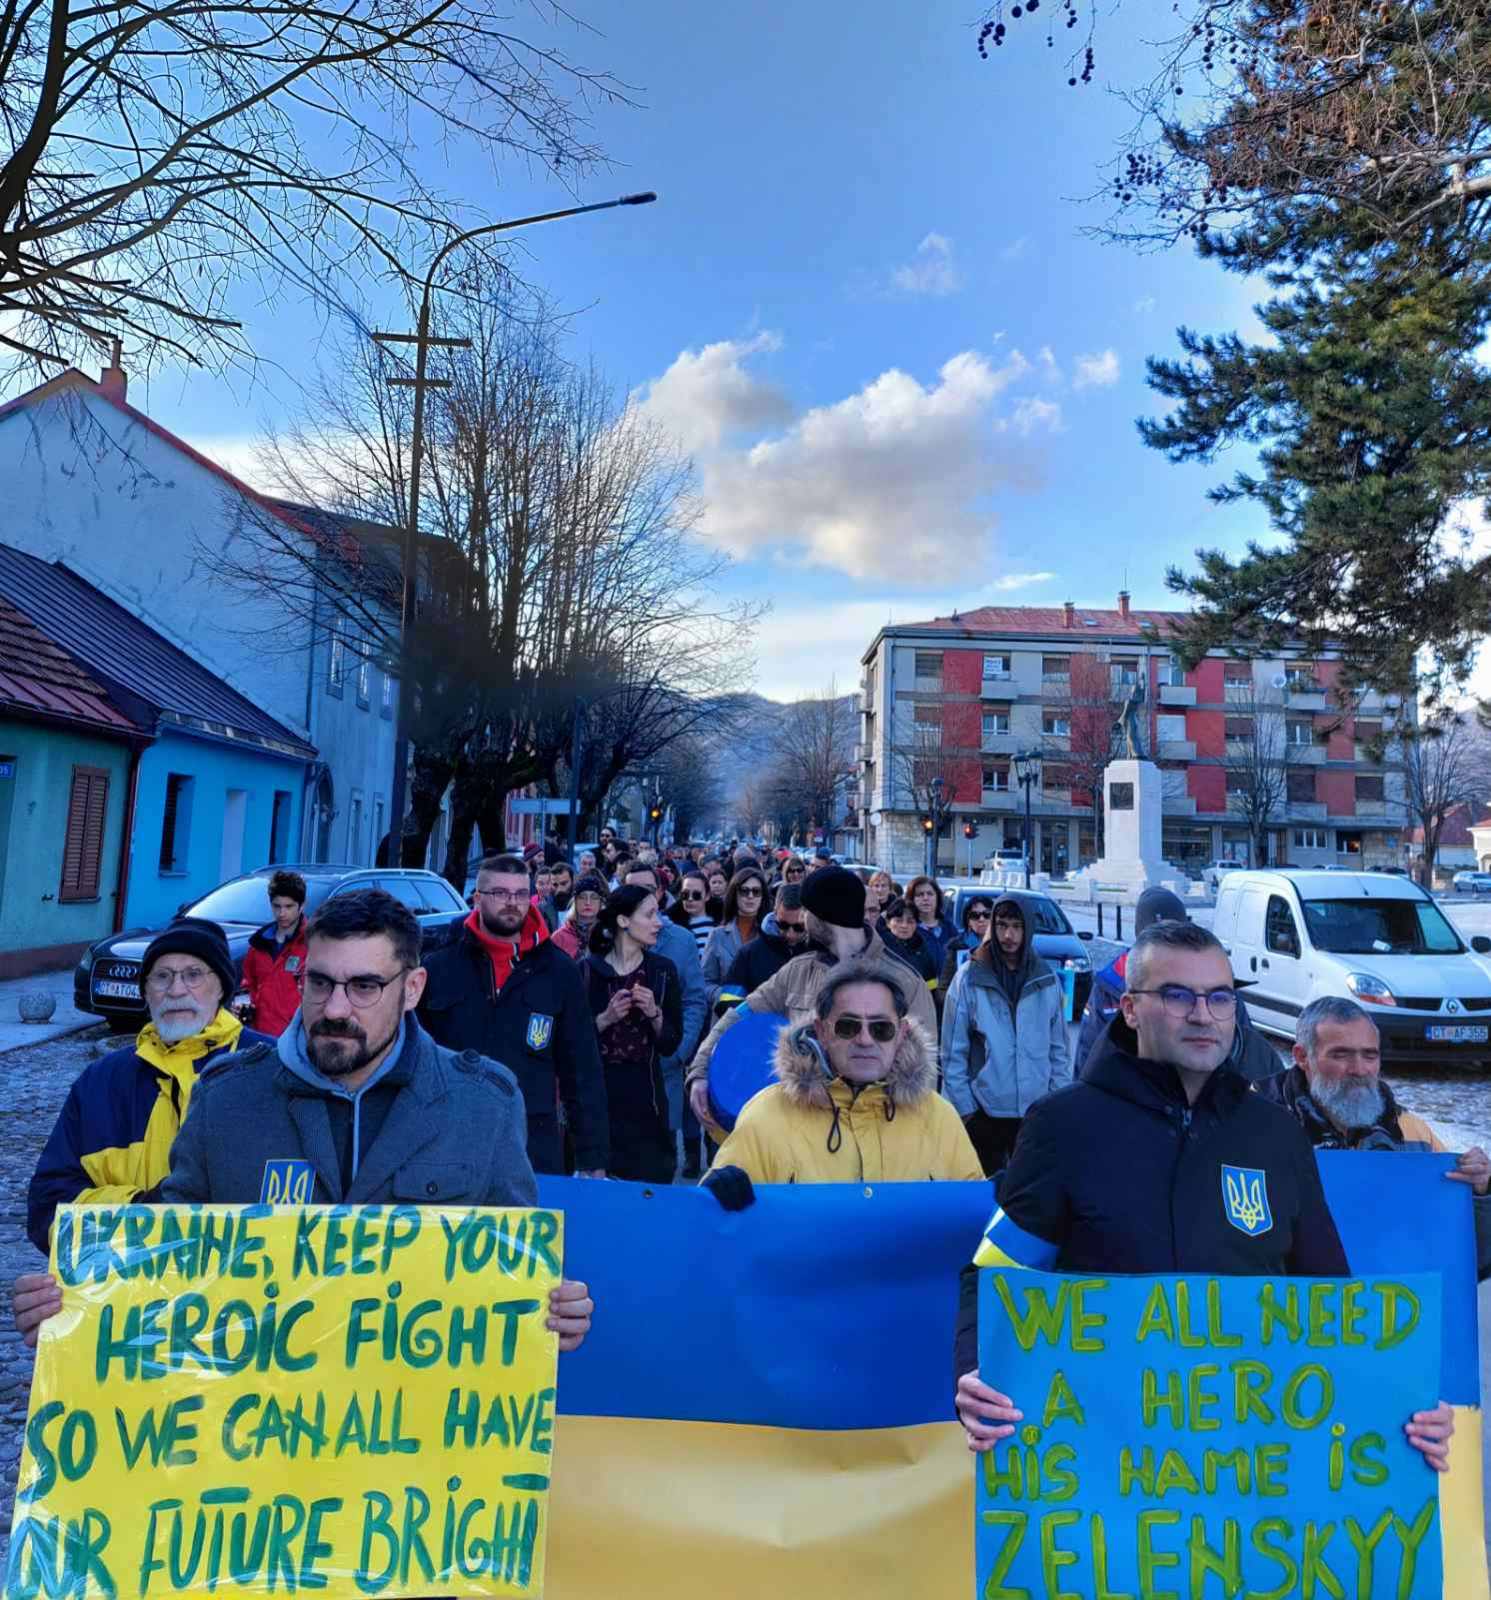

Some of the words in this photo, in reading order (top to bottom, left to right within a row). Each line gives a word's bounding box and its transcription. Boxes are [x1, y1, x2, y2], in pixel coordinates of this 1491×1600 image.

[292, 1204, 422, 1280] KEEP
[440, 1209, 561, 1283] YOUR
[993, 1274, 1108, 1352] WE
[1136, 1279, 1243, 1348] ALL
[1258, 1282, 1421, 1351] NEED
[1043, 1371, 1084, 1428] A
[18, 1400, 99, 1503] SO
[115, 1395, 205, 1470] WE
[334, 1388, 420, 1457] ALL
[443, 1387, 556, 1454] HAVE
[139, 1486, 343, 1600] FUTURE
[982, 1498, 1436, 1600] ZELENSKYY
